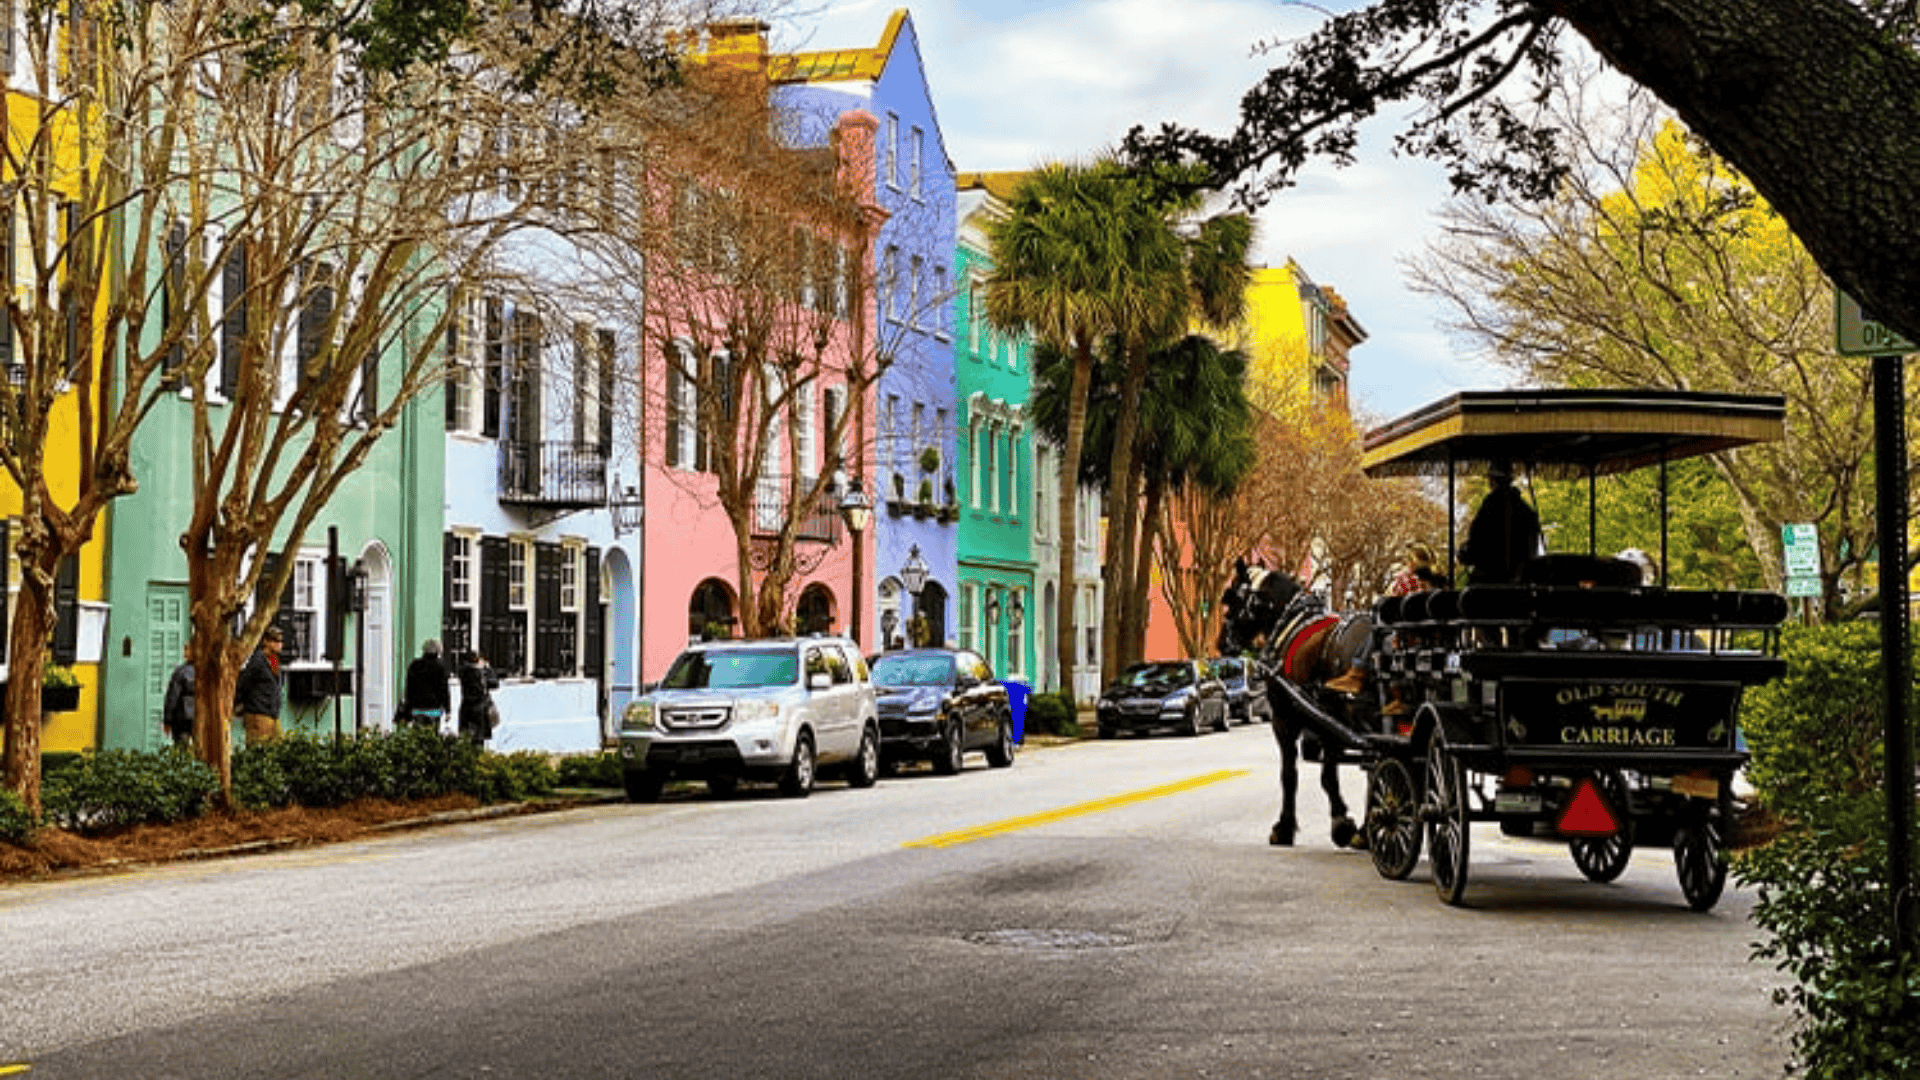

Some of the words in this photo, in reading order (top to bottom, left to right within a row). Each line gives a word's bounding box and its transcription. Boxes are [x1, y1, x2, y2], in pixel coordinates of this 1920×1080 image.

[1556, 685, 1603, 705] OLD
[1608, 683, 1685, 707] SOUTH
[1560, 726, 1676, 746] CARRIAGE
